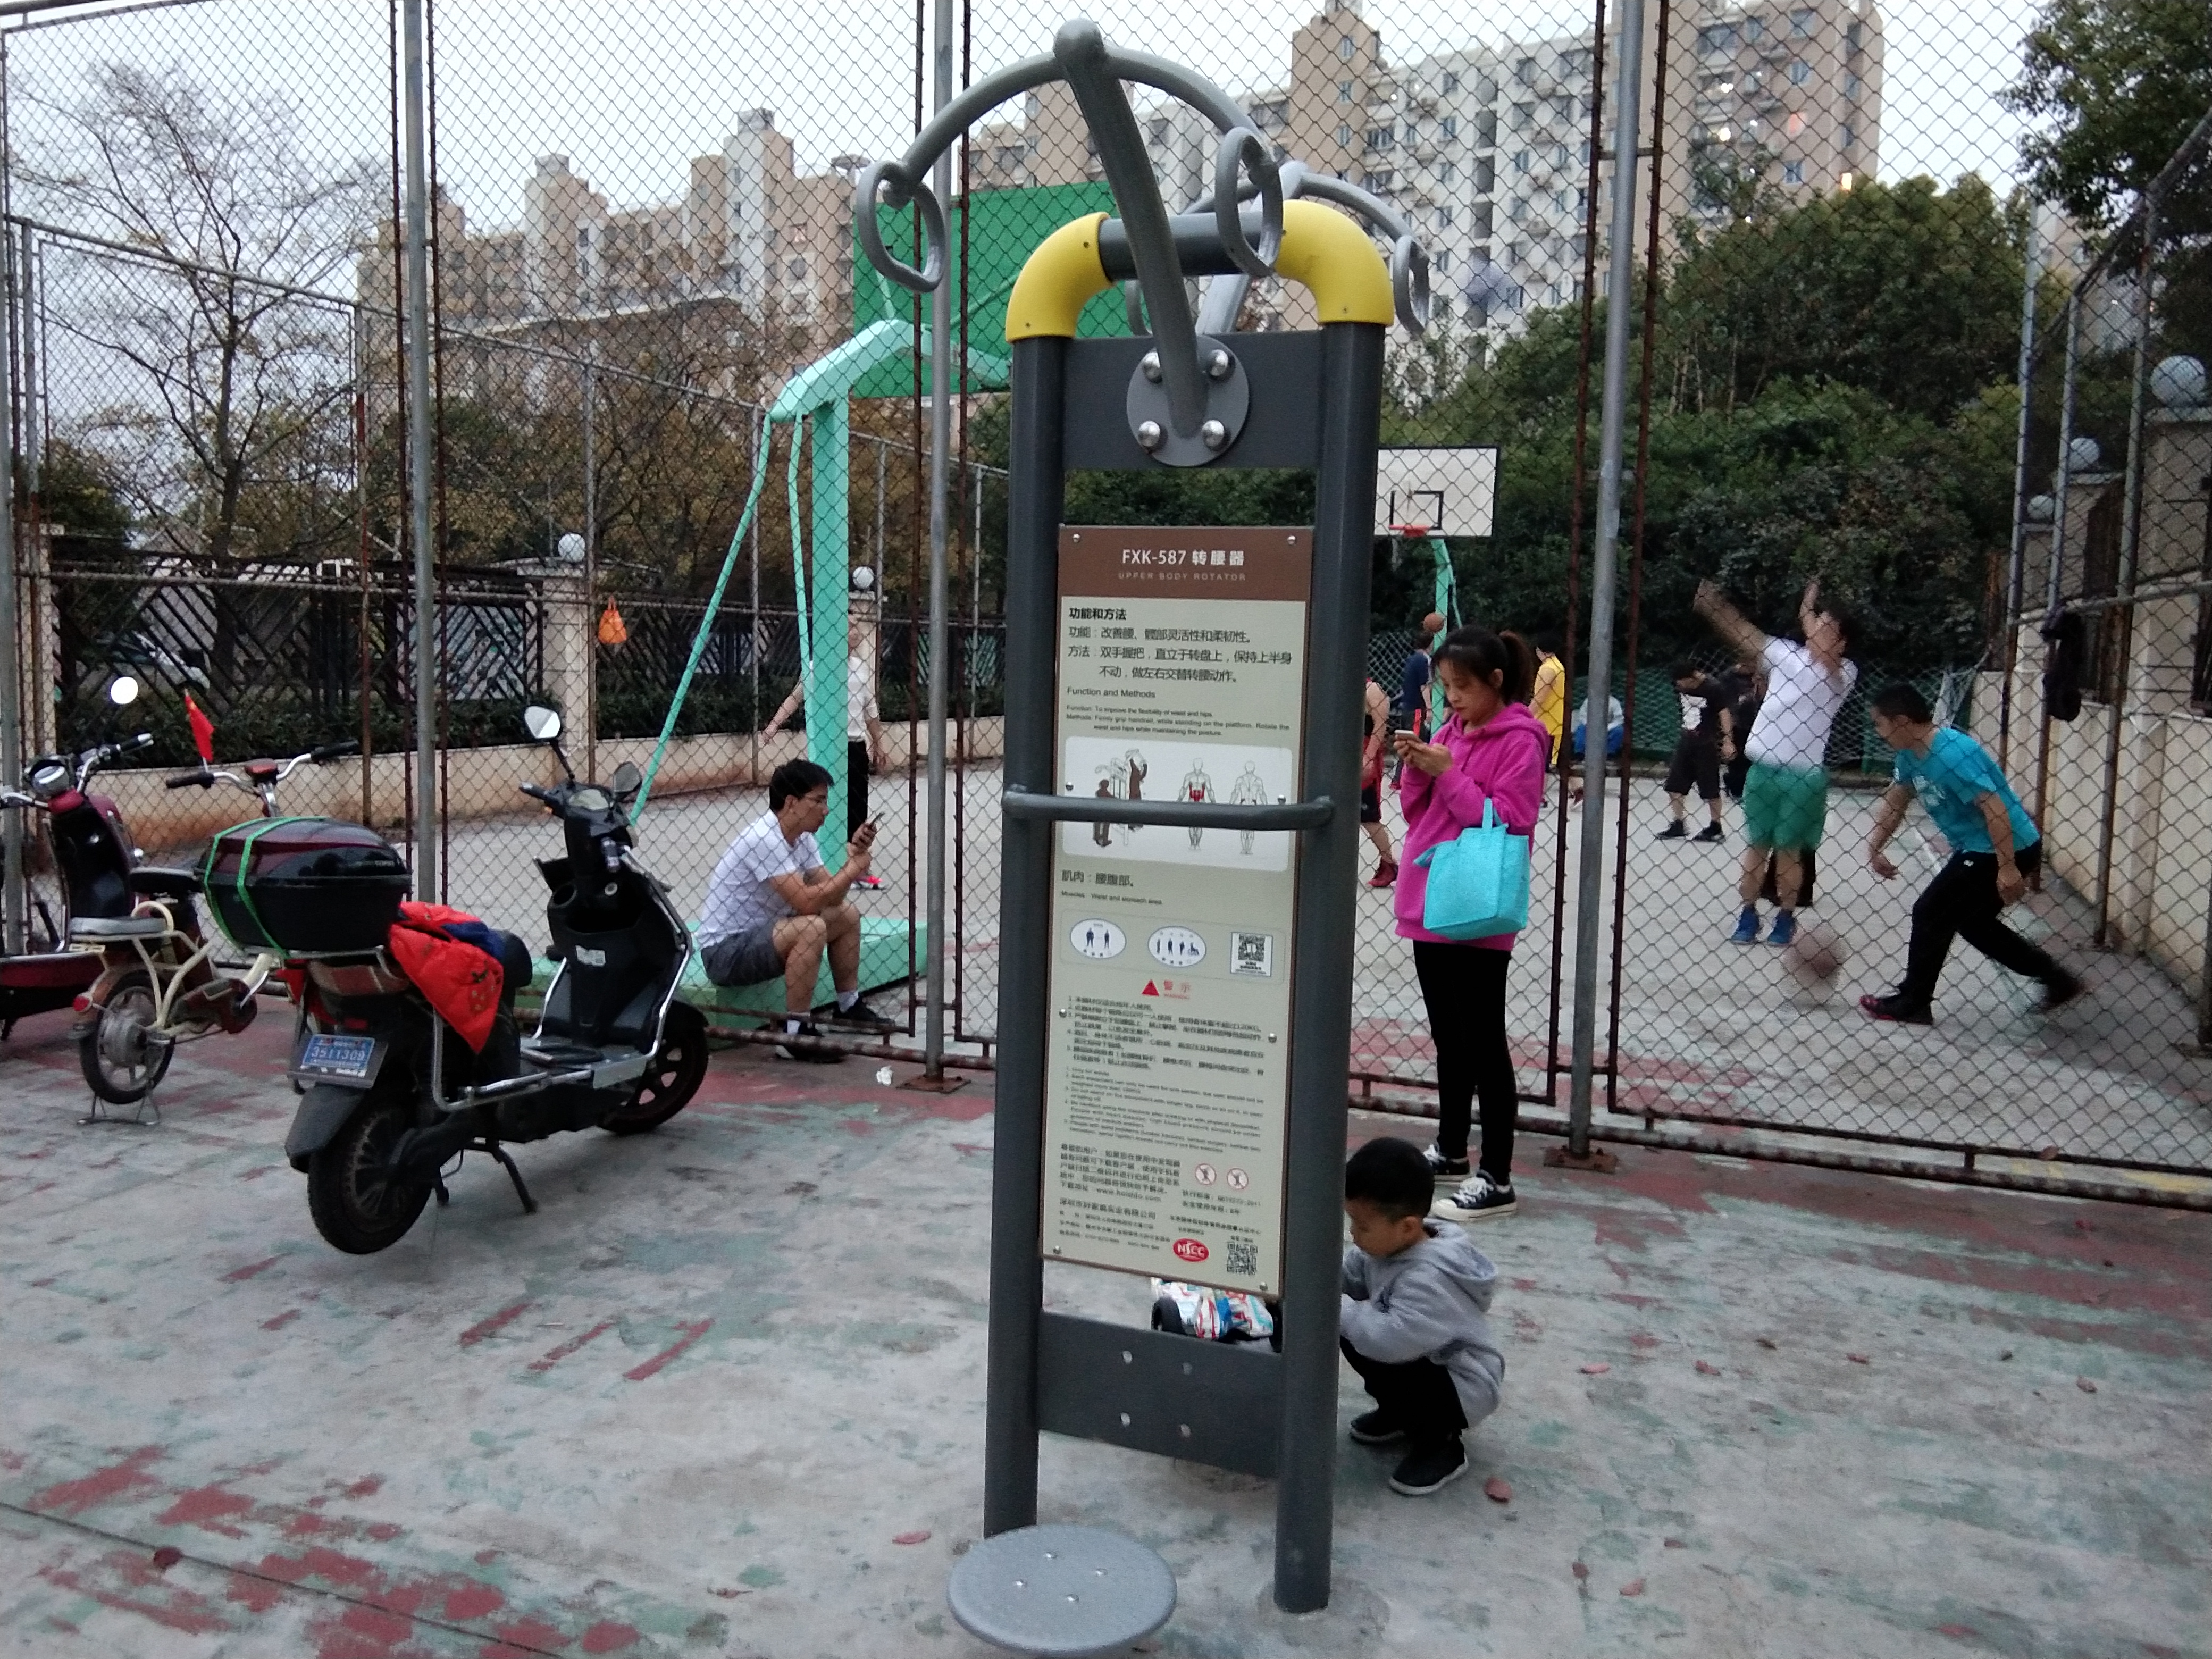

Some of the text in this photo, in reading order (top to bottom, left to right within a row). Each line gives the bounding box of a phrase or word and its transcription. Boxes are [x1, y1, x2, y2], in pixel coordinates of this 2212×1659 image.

[1122, 549, 1244, 565] FXK-587 转腰器
[1193, 573, 1245, 581] ROTATOR
[1069, 607, 1127, 620] 功能和方法
[1067, 686, 1155, 699] Function and Methods
